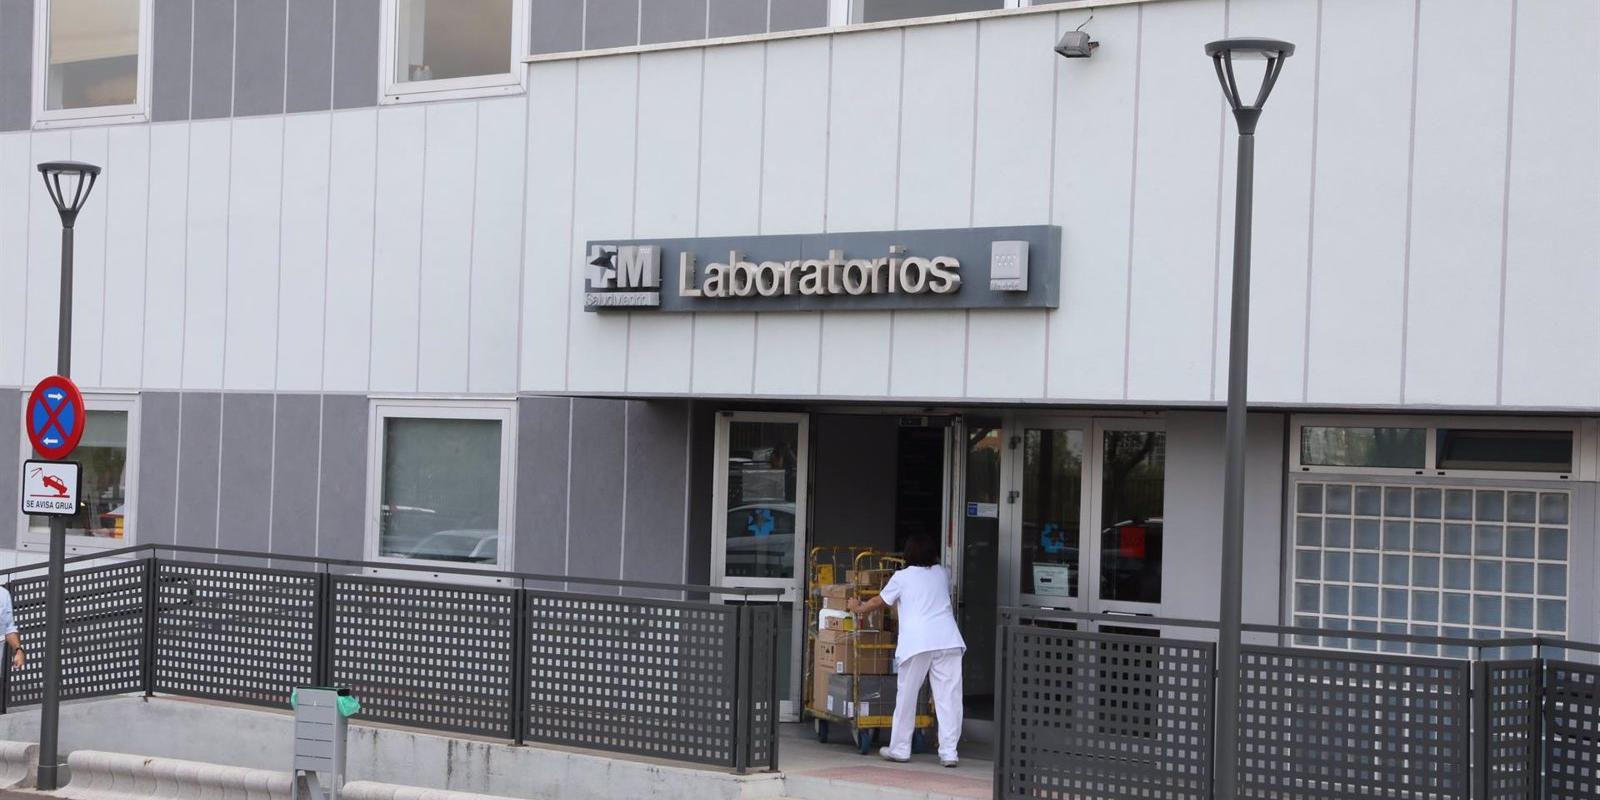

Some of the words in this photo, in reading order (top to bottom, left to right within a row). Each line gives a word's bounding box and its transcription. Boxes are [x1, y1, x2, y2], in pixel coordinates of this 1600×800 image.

[679, 245, 960, 297] Laboratorios
[26, 500, 34, 508] SE
[36, 500, 54, 509] AVISA
[55, 501, 73, 510] GRUA
